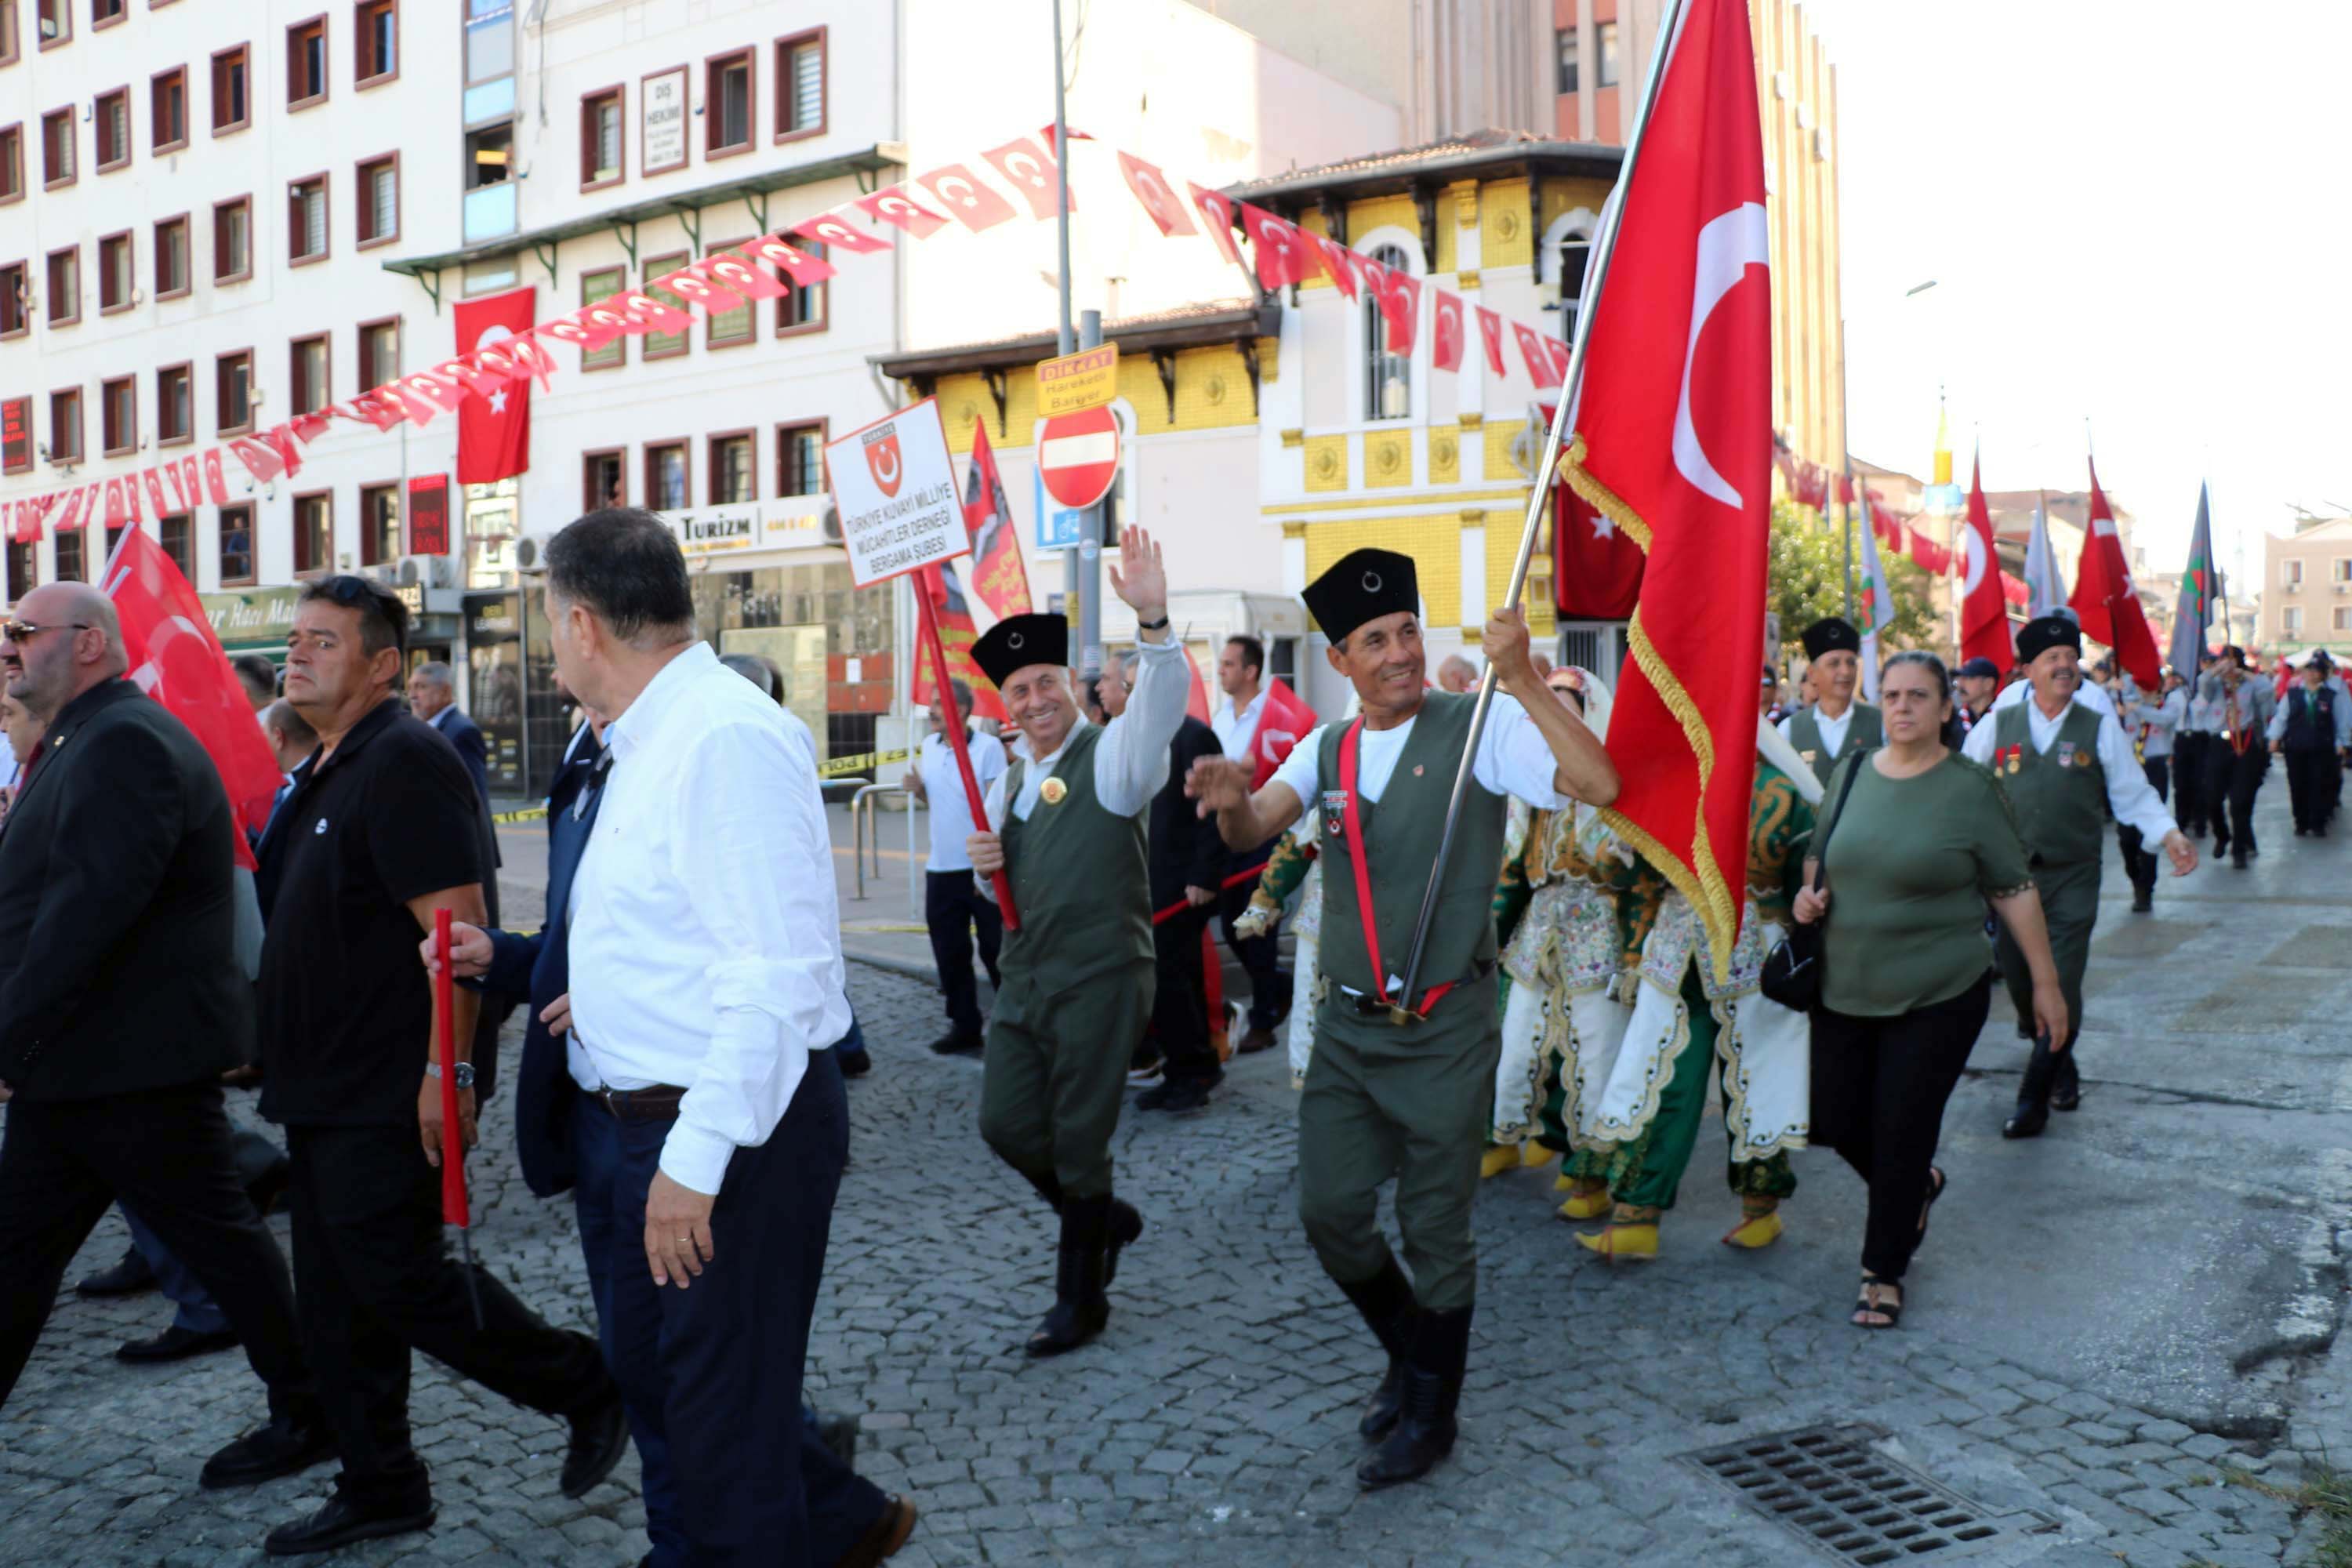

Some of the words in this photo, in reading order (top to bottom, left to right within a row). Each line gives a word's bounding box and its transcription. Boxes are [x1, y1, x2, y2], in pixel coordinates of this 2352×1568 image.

[1044, 352, 1111, 379] DİKKAT
[846, 507, 884, 535] TÜRKİYE
[914, 482, 953, 510] MİLLİYE
[856, 522, 912, 556] MÜCAHİTLER
[910, 504, 952, 536] DERNEĞİ
[869, 549, 913, 574] BERGAMA
[913, 531, 948, 561] ŞUBESİ
